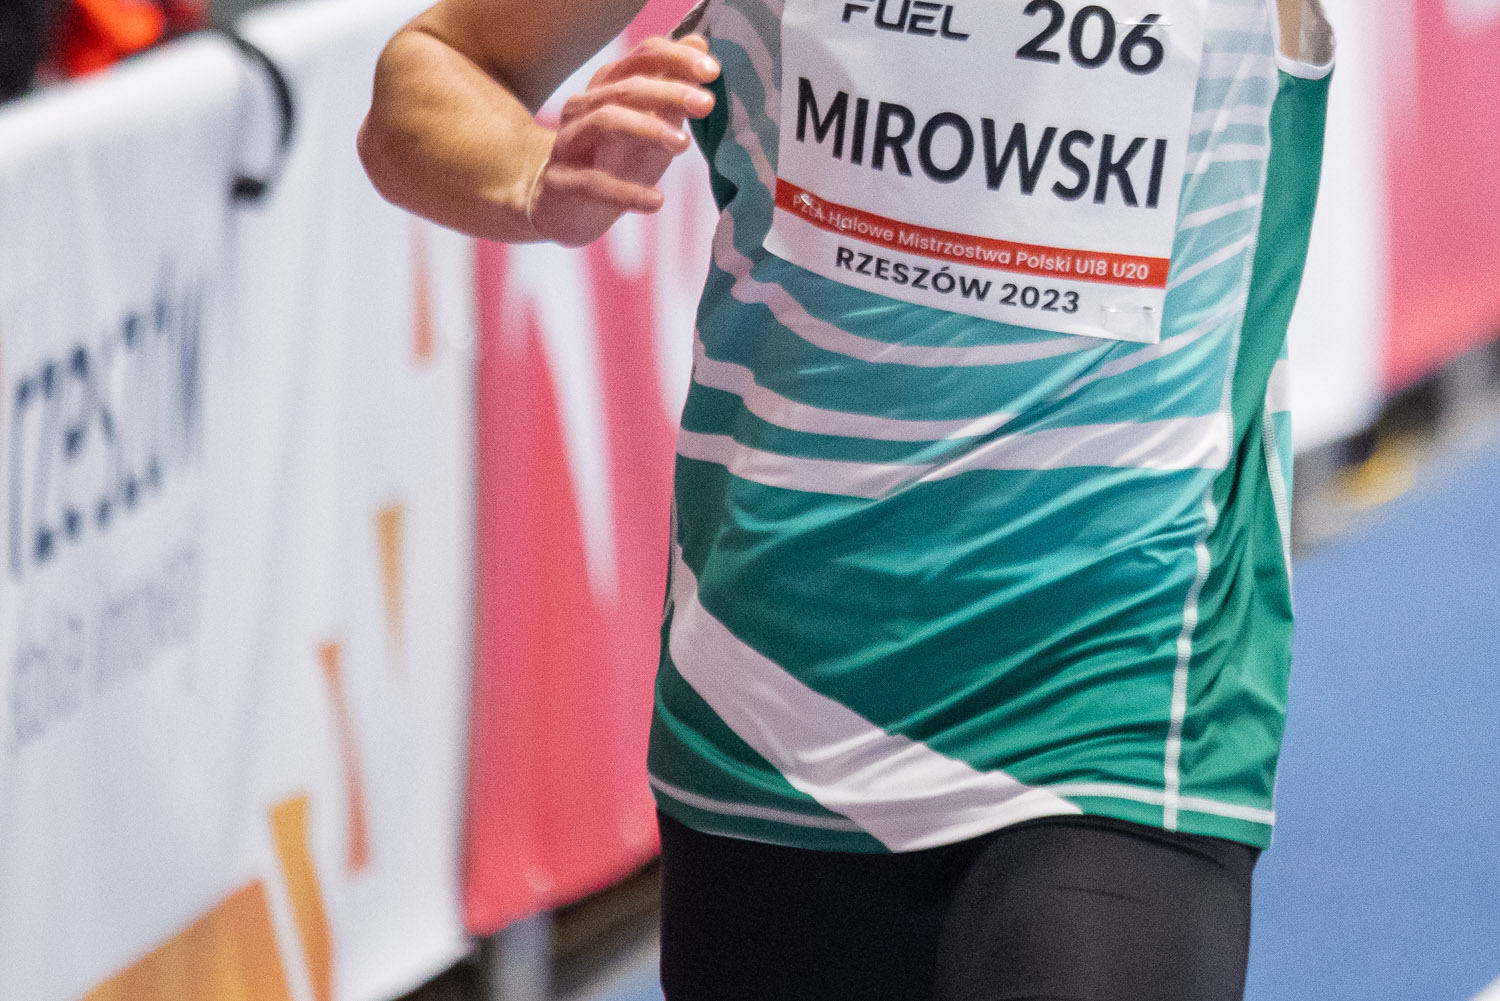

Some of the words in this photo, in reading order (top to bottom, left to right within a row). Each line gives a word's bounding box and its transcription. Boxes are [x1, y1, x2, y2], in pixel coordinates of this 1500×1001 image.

[795, 76, 1168, 210] MIROWSKI
[829, 211, 894, 241] Halowe
[898, 230, 1010, 265] Mistrzostwa
[1016, 252, 1071, 273] Polski
[1075, 259, 1107, 276] U18
[1112, 263, 1149, 280] U20
[835, 246, 992, 301] RZESZÓW
[999, 283, 1080, 314] 2023
